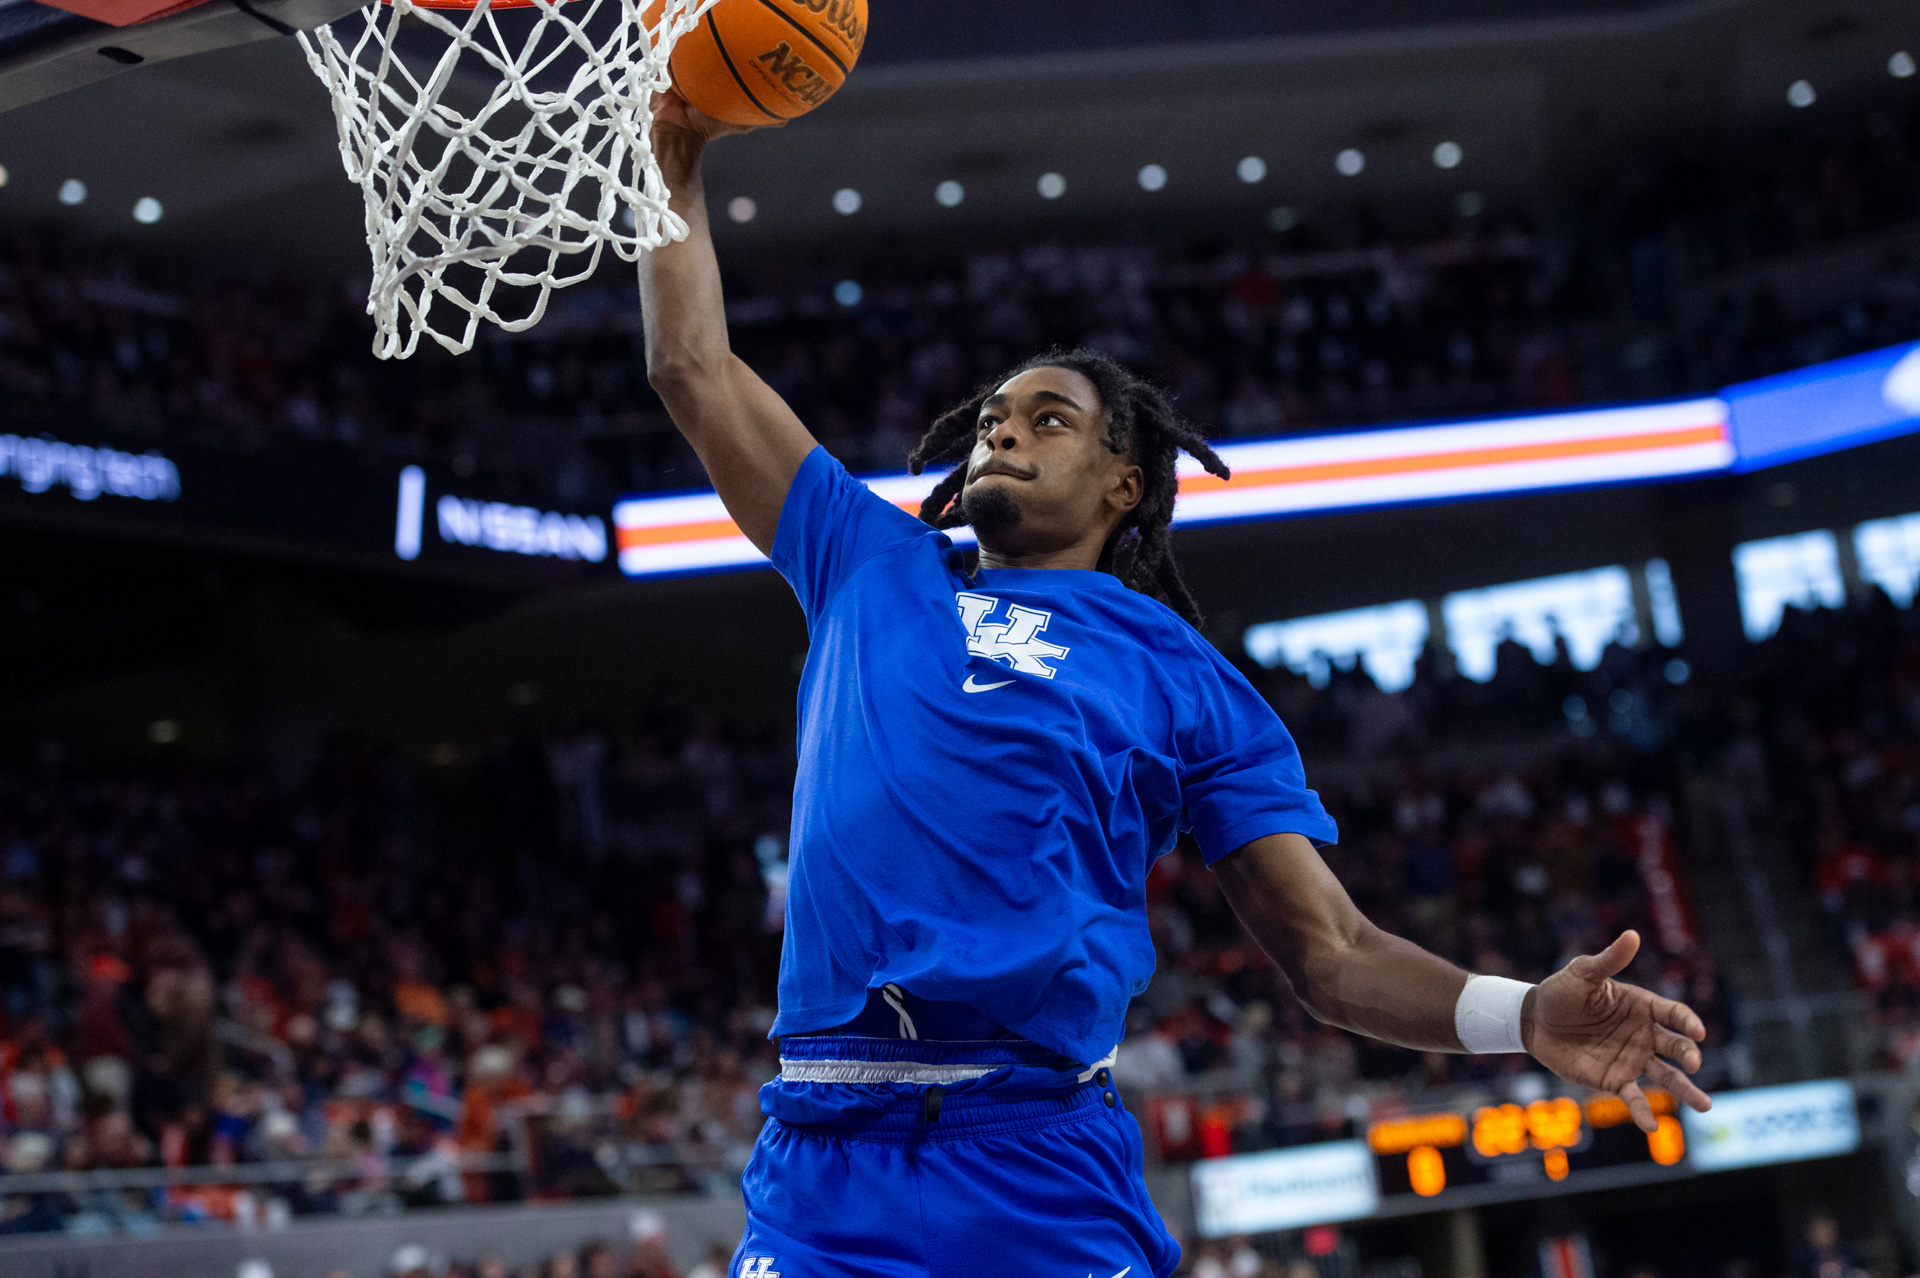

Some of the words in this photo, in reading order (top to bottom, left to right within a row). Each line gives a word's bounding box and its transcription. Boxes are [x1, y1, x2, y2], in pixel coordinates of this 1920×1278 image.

[756, 40, 834, 107] NCAA
[437, 494, 607, 563] NISSAN
[955, 592, 1071, 680] UK
